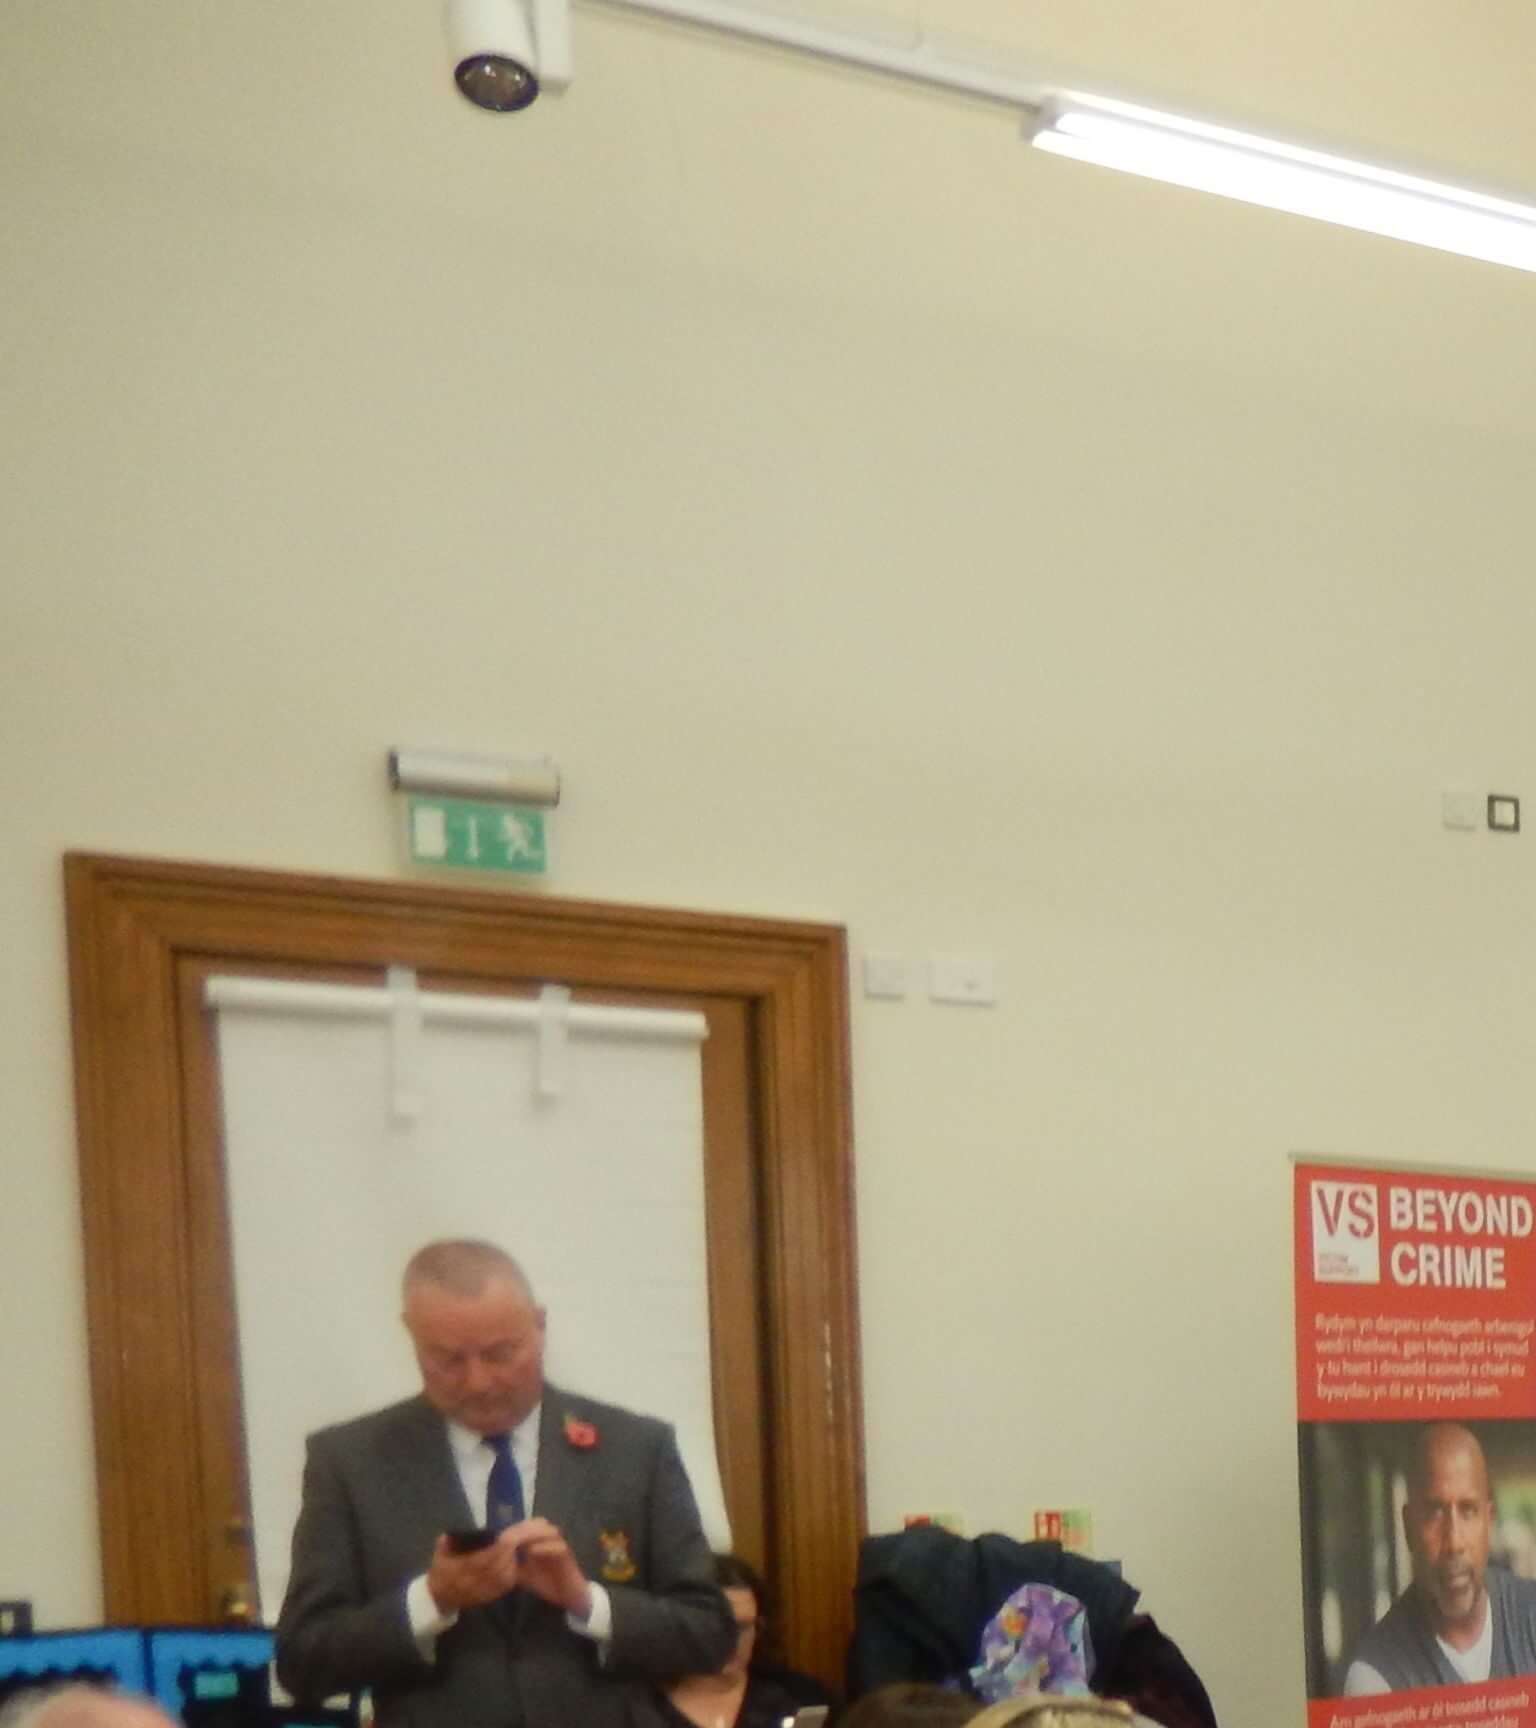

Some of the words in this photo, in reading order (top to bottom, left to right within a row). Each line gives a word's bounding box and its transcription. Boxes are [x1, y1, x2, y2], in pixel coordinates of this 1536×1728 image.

[1317, 1188, 1375, 1239] VS
[1390, 1187, 1534, 1237] BEYOND
[1391, 1242, 1507, 1290] CRIME
